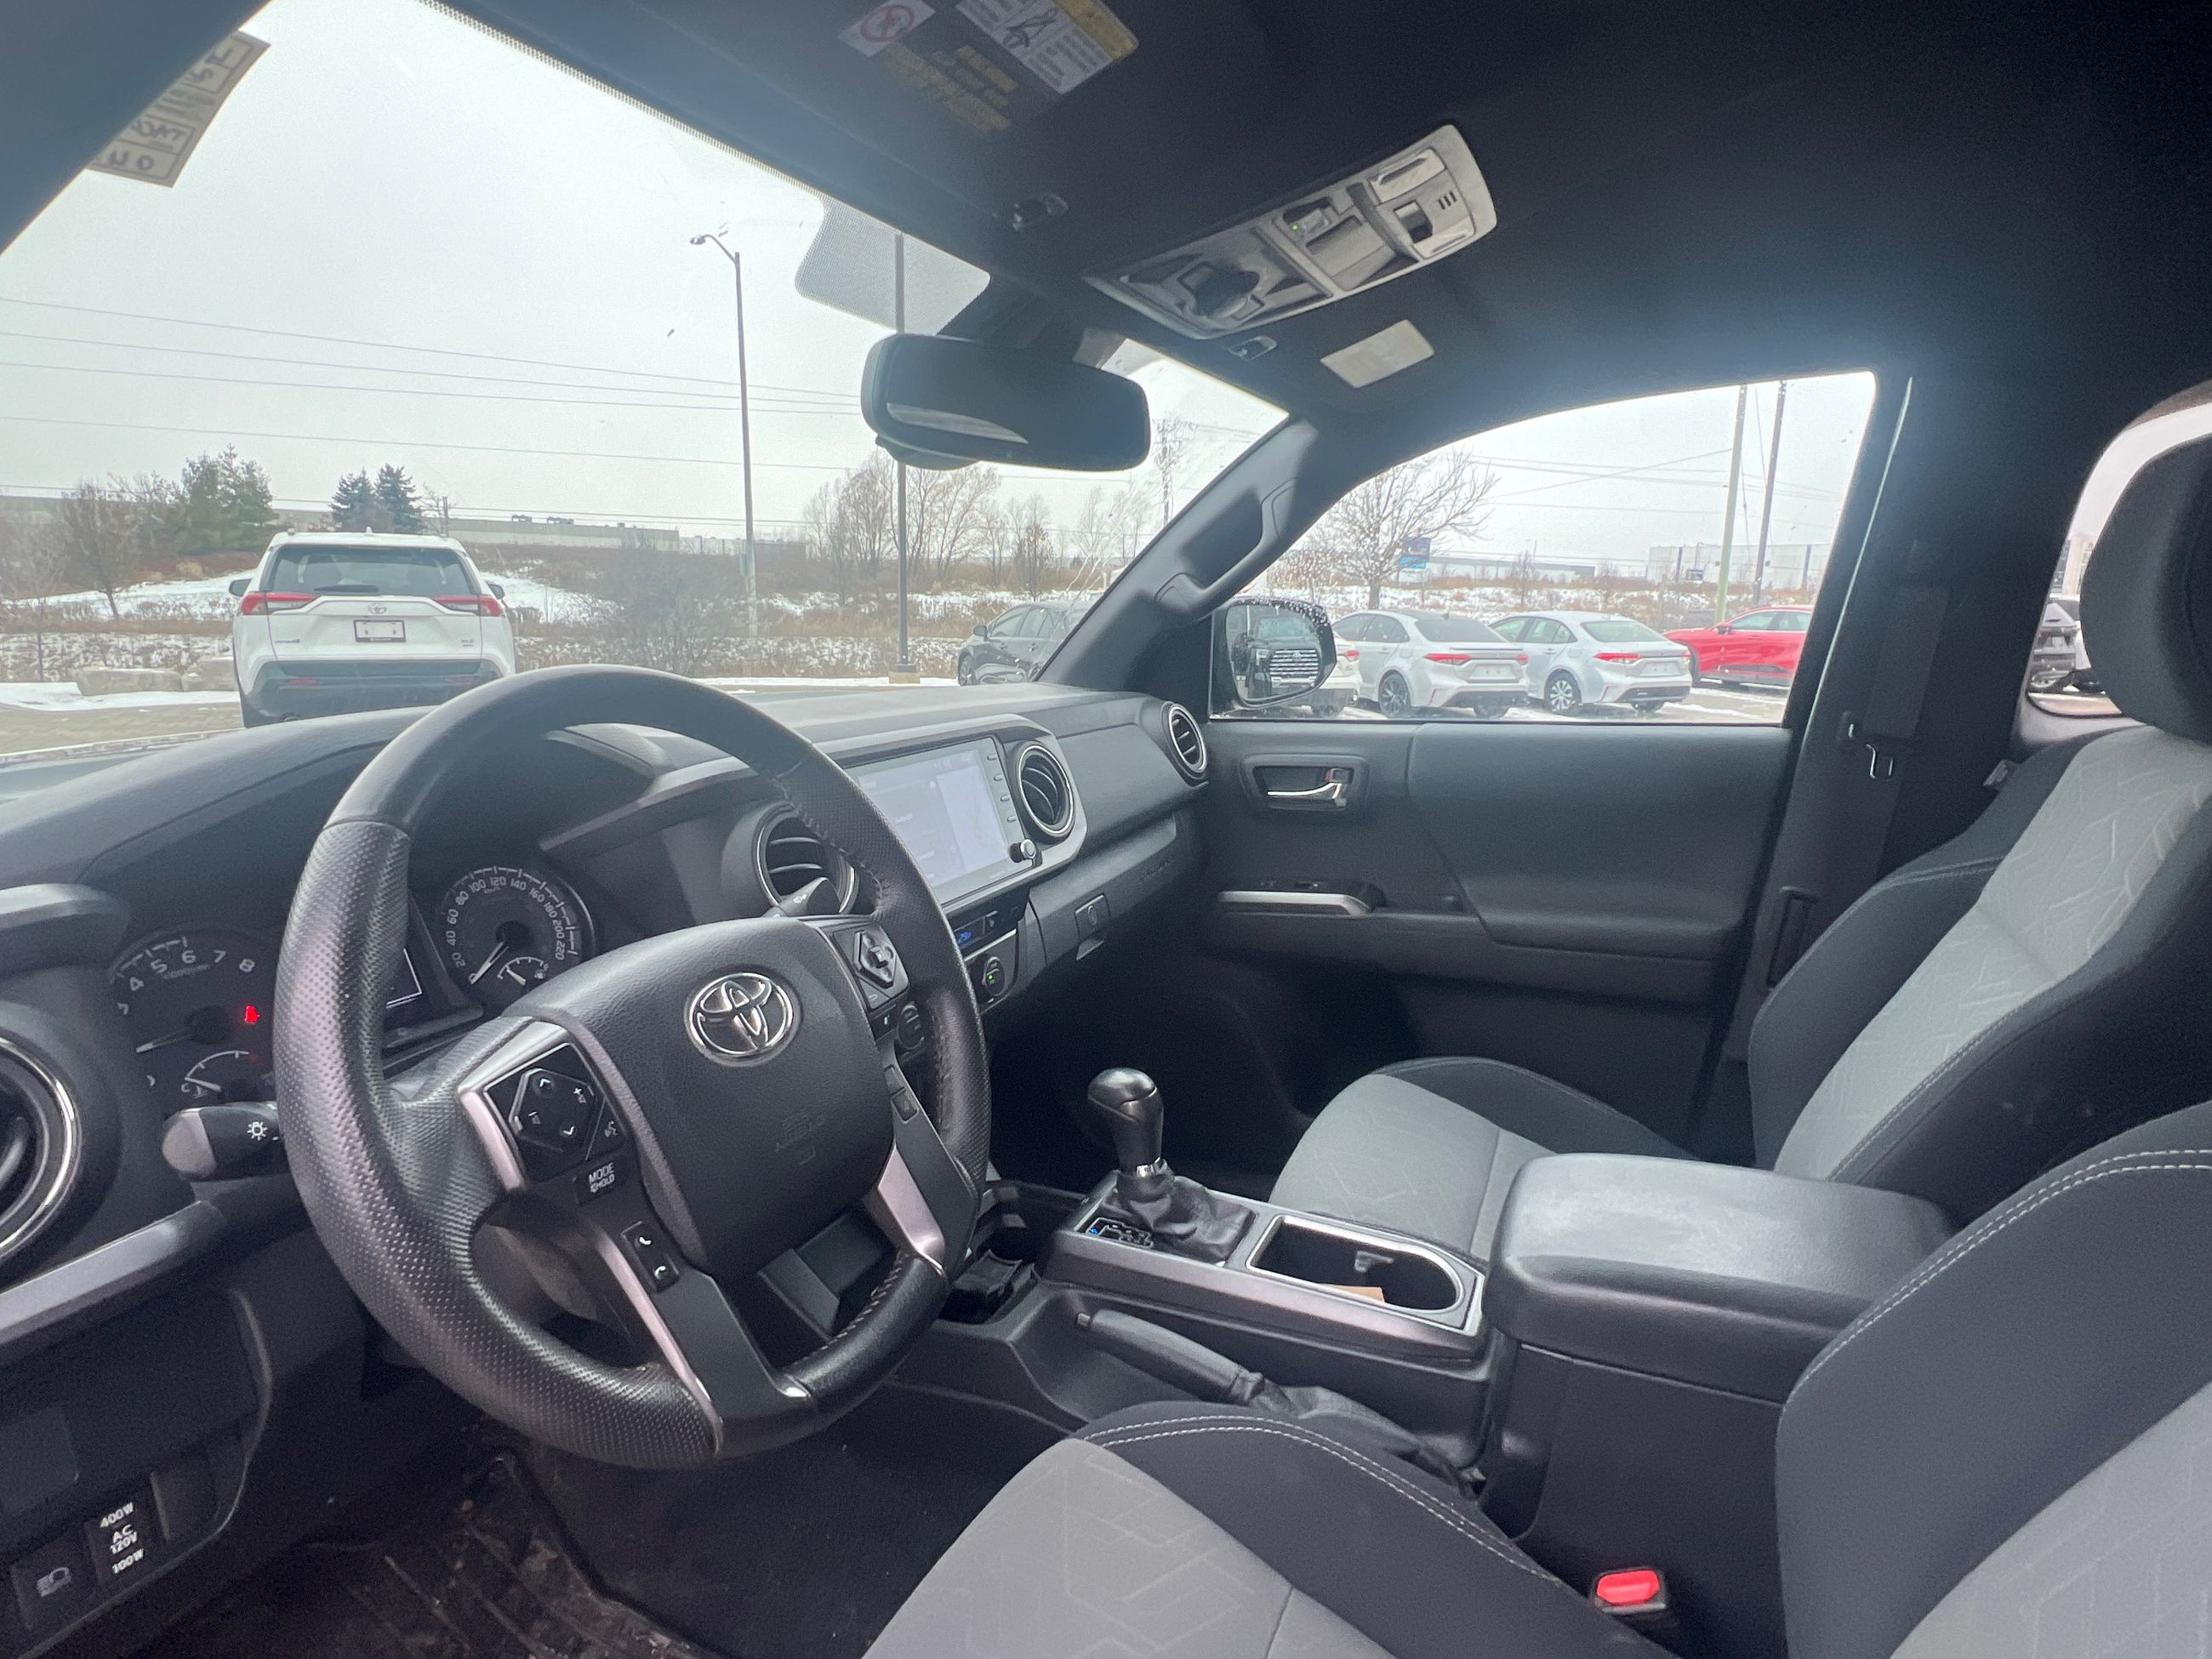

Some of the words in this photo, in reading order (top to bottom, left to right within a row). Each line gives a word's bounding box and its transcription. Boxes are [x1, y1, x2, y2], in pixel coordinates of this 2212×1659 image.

[468, 879, 487, 893] 100
[490, 875, 507, 887] 120
[510, 877, 527, 892] 140
[455, 891, 470, 906] 80
[529, 887, 545, 904] 160
[447, 909, 459, 925] 60
[544, 902, 558, 919] 180
[552, 919, 565, 939] 200
[445, 930, 457, 946] 40
[181, 949, 197, 964] 6
[214, 949, 227, 963] 7
[555, 940, 566, 961] 220
[150, 958, 168, 974] 5
[238, 958, 255, 973] 8
[451, 952, 466, 967] 20
[129, 977, 145, 992] 4
[589, 1161, 614, 1185] MODE
[100, 1502, 134, 1529] 400W
[112, 1524, 134, 1543] AC
[109, 1531, 138, 1555] 120V
[111, 1548, 144, 1574] 100W
